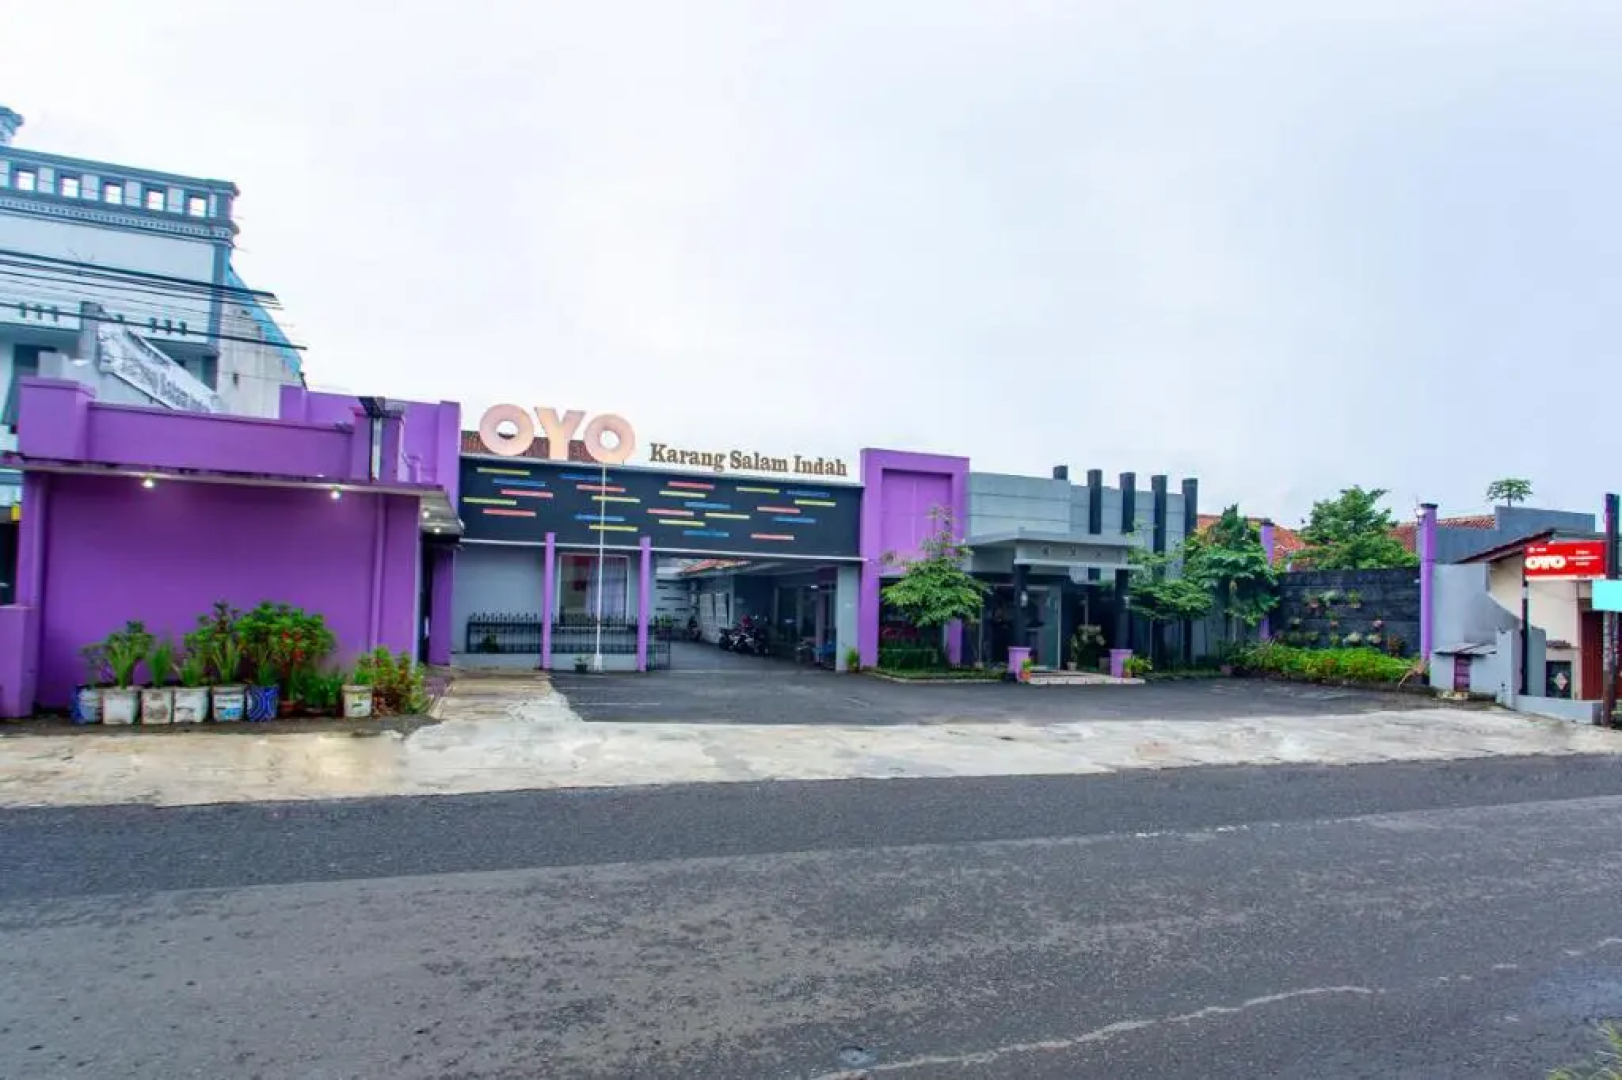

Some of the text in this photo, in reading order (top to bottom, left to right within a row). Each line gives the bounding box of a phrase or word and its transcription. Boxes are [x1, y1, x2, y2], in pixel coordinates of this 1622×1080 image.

[479, 404, 635, 464] OYO
[650, 442, 848, 476] Karang Salam Indah
